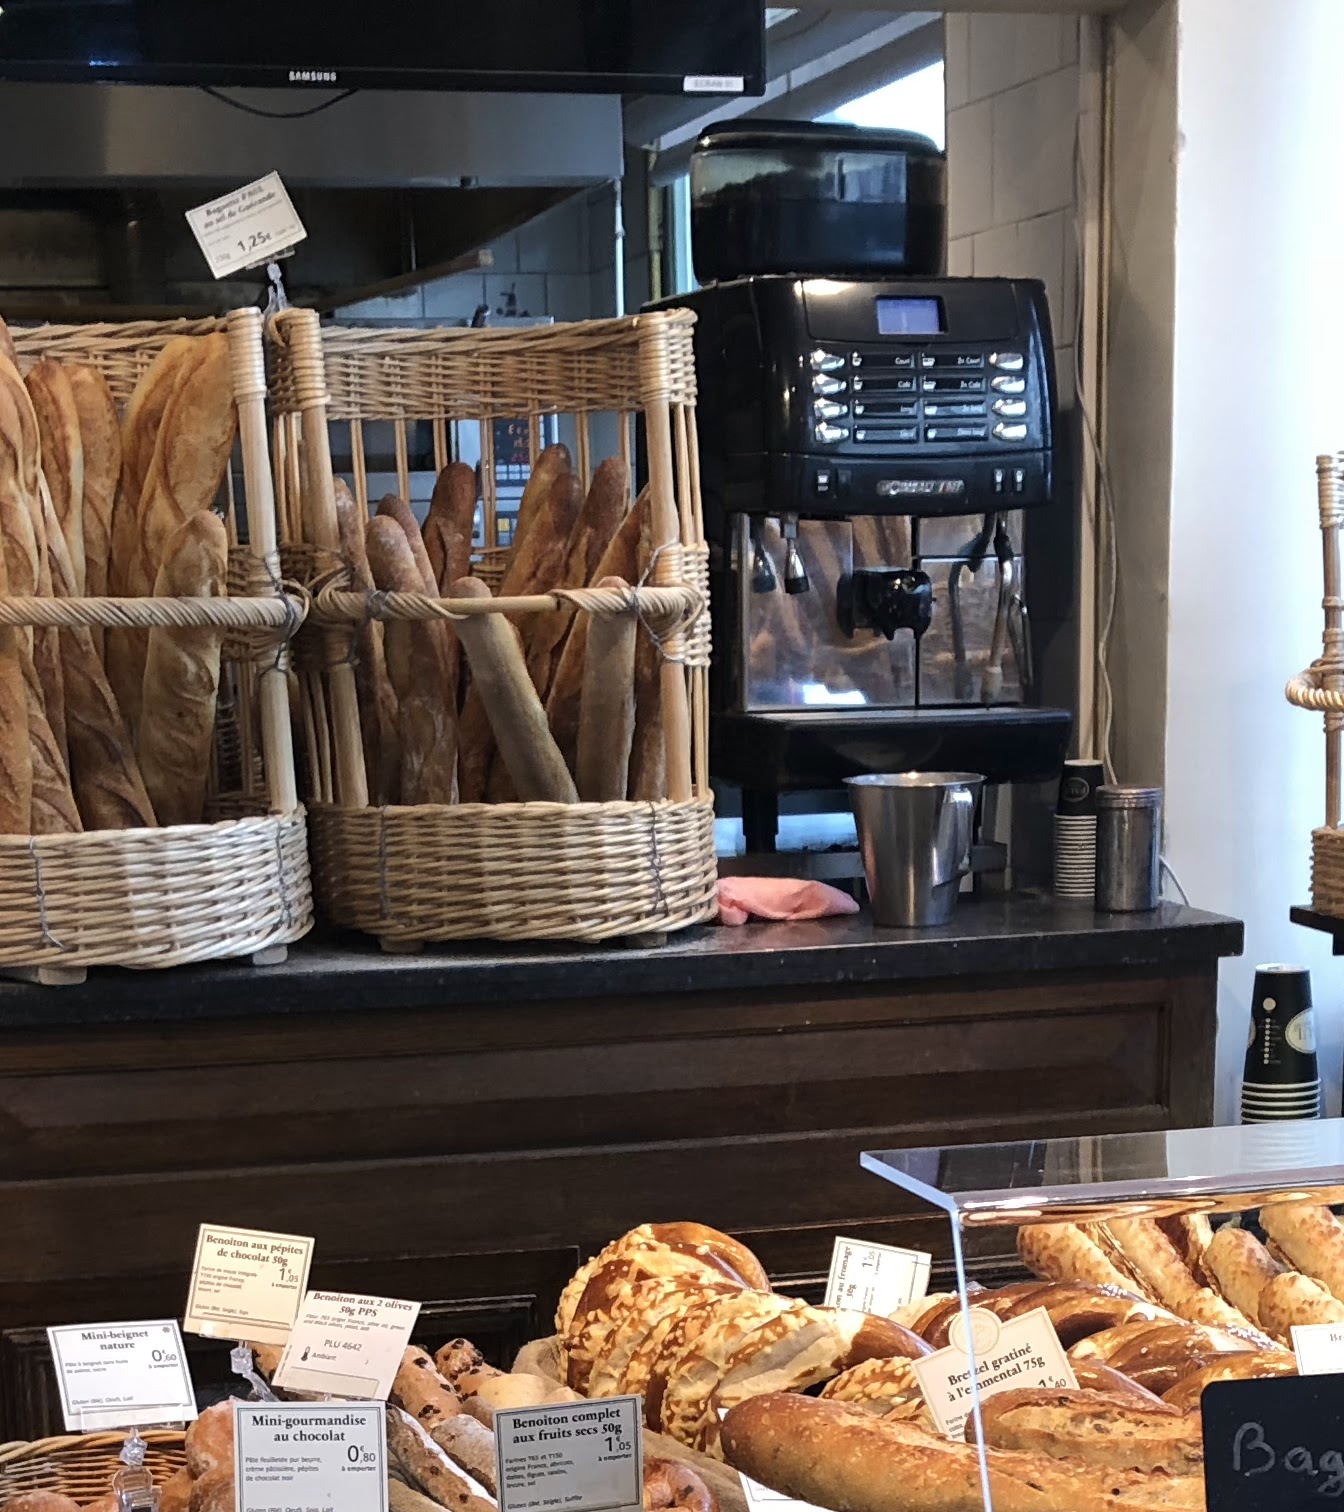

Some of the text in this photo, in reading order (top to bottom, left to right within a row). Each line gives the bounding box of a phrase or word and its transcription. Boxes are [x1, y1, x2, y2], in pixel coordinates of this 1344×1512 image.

[289, 71, 336, 81] SAMSUNG
[238, 231, 272, 251] 1,25€
[207, 1235, 303, 1255] Benoiton aux pépites
[217, 1248, 288, 1267] de chocolat 50g
[838, 1246, 852, 1280] fromage
[846, 1284, 857, 1298] 50g
[313, 1293, 355, 1304] Benoiton
[385, 1300, 412, 1311] olives
[339, 1306, 378, 1316] 50g PPS
[81, 1330, 149, 1340] Mini-beignet
[100, 1342, 135, 1350] nature
[324, 1339, 362, 1351] PLU 4642
[948, 1343, 1032, 1386] Bretzel gratiné
[947, 1392, 955, 1402] à
[1024, 1356, 1045, 1371] 75g
[252, 1414, 366, 1429] Mini-gourmandise
[513, 1408, 621, 1429] Benoiton complet
[274, 1430, 345, 1441] au chocolat
[513, 1423, 622, 1443] aux fruits secs 50g
